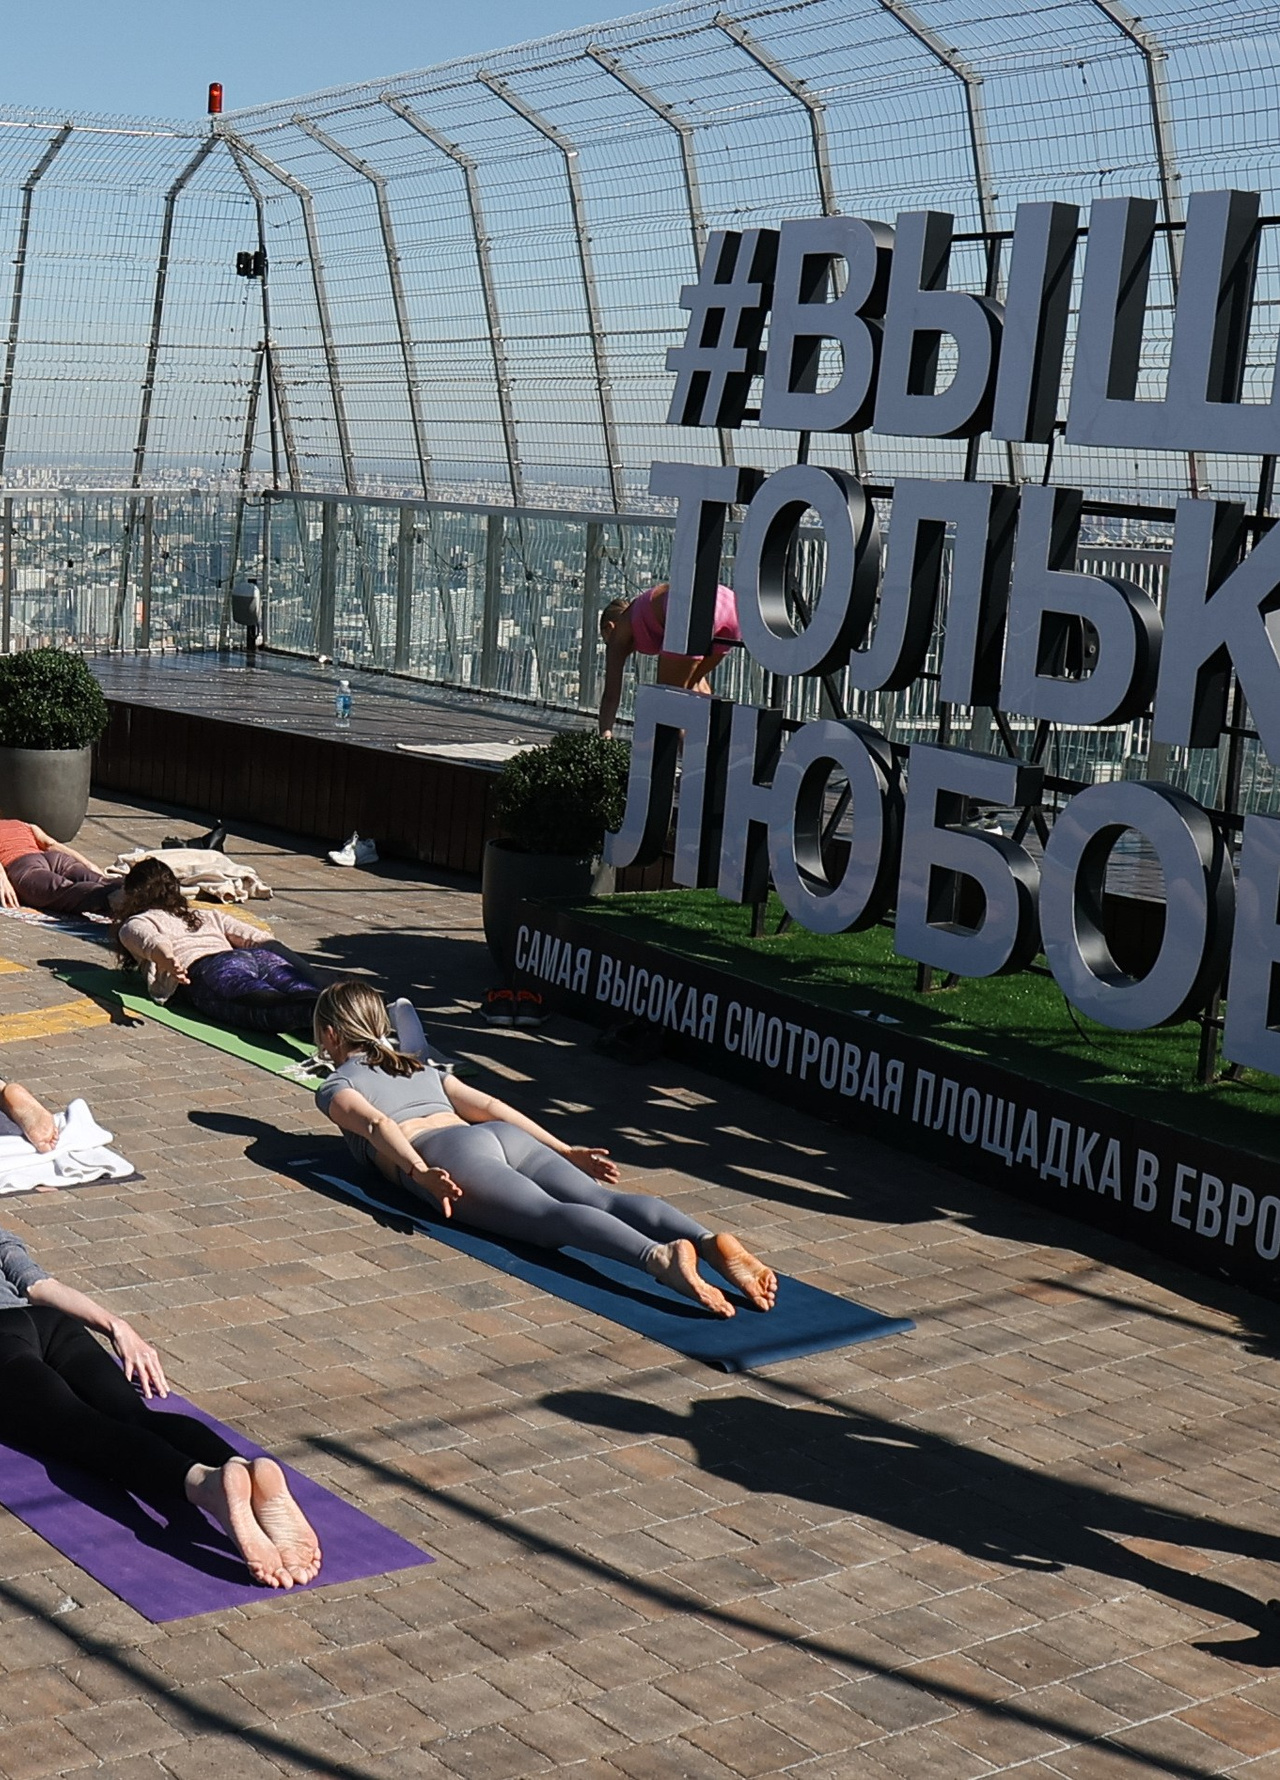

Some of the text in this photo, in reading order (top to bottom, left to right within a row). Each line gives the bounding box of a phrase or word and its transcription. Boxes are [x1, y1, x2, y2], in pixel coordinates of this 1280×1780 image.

[649, 461, 1280, 767] ТОЛЬК
[515, 925, 1280, 1260] САМАЯ ВЫСОКАЯ СМОТРОВАЯ ПЛОЩАДКА В ЕВРО
